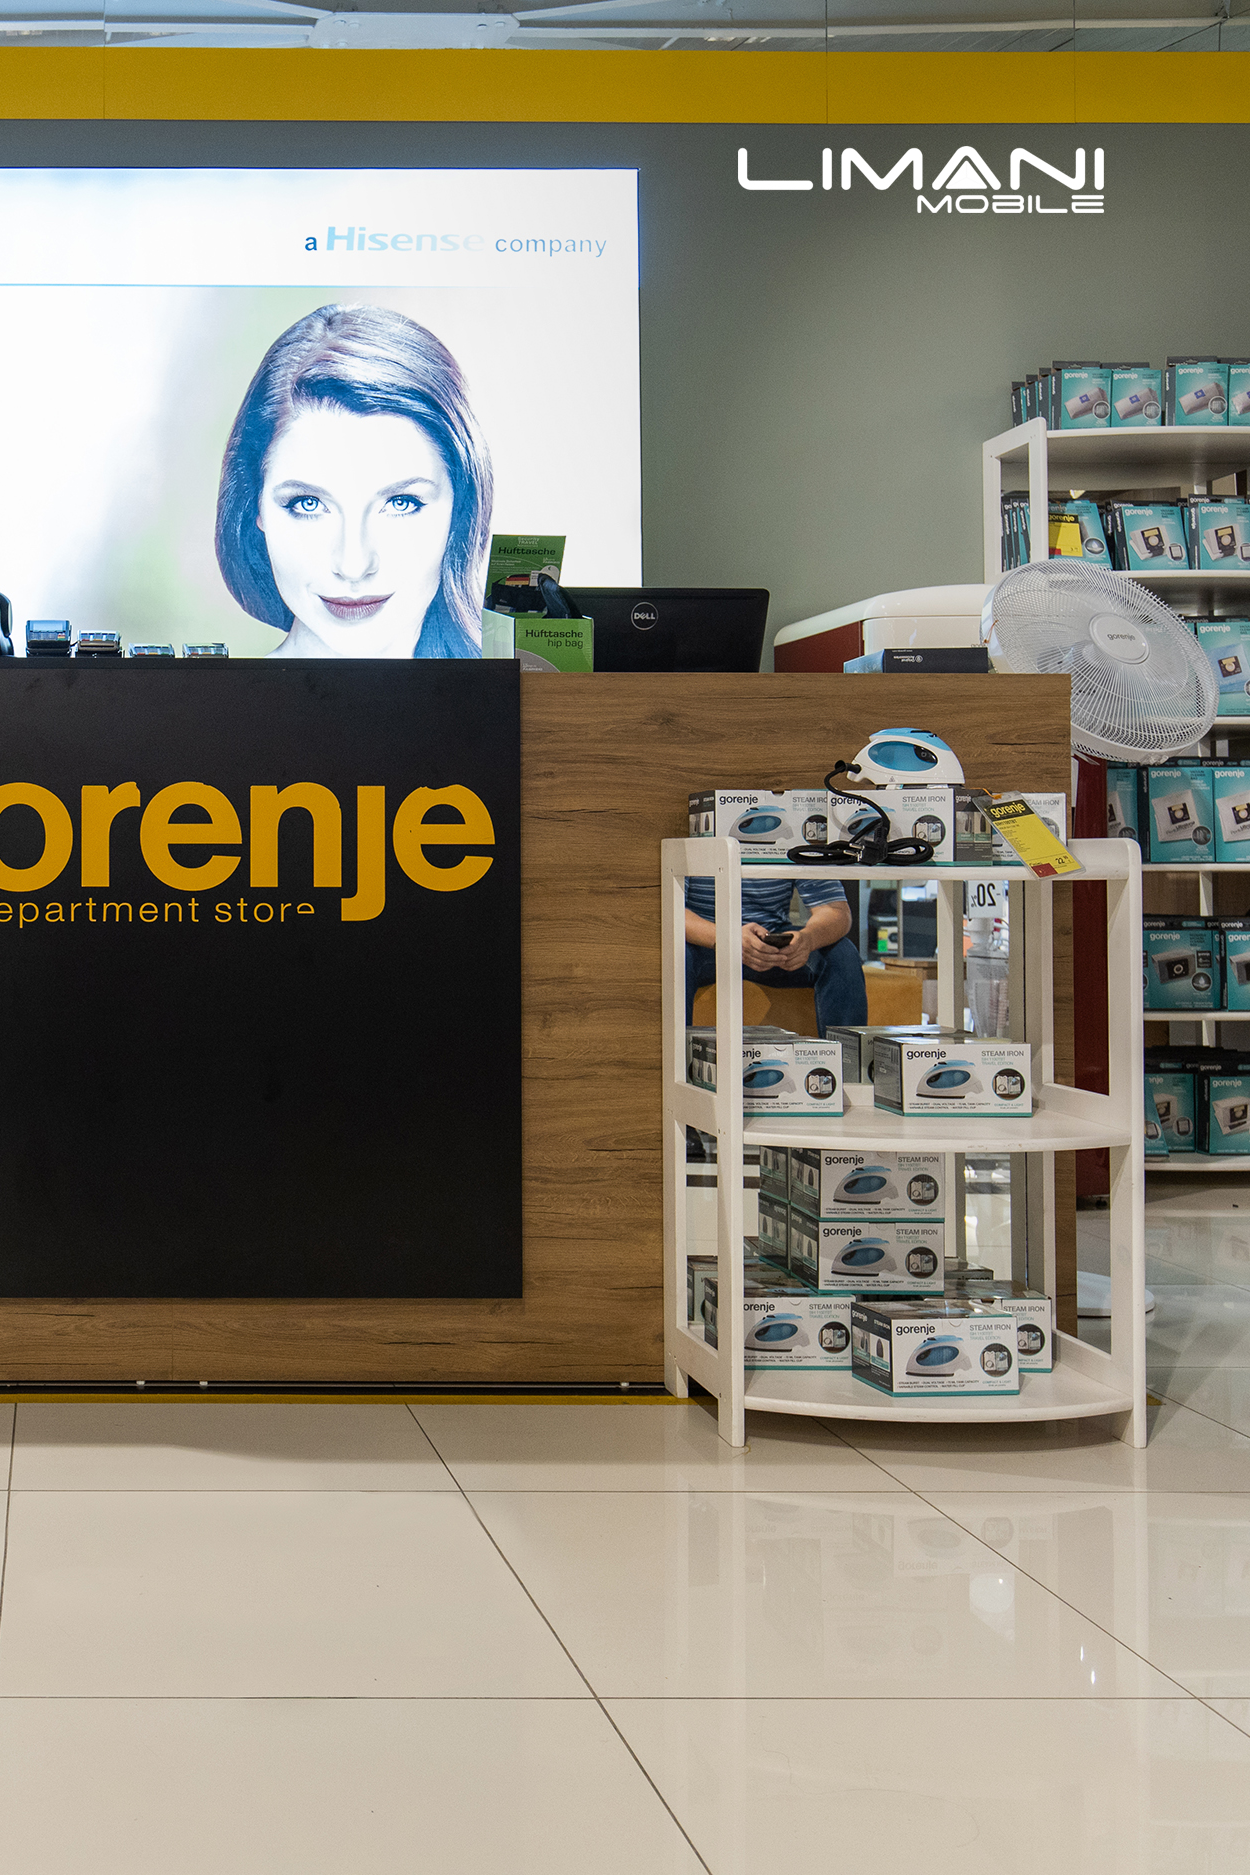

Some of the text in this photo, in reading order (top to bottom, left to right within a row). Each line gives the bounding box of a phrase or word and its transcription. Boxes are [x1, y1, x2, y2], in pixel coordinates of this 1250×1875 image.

[305, 226, 607, 258] a Hisense company
[1124, 508, 1153, 516] gorenje
[1201, 505, 1229, 514] gorenje
[634, 612, 656, 620] DELL
[525, 629, 584, 638] Hüfttasche
[1199, 624, 1231, 634] gorenje
[1107, 633, 1136, 641] gorenje
[547, 639, 584, 649] hip bag
[1150, 769, 1181, 778] gorenje
[1214, 769, 1245, 778] gorenje
[719, 794, 759, 806] gorenje
[990, 802, 1026, 819] gorenje
[1149, 932, 1181, 941] gorenje
[906, 1049, 947, 1060] gorenje
[1212, 1079, 1242, 1088] gorenje
[824, 1154, 864, 1166] gorenje
[822, 1226, 862, 1237] gorenje
[743, 1301, 776, 1313] orenje
[851, 1310, 868, 1322] gorenje
[895, 1324, 936, 1336] gorenje
